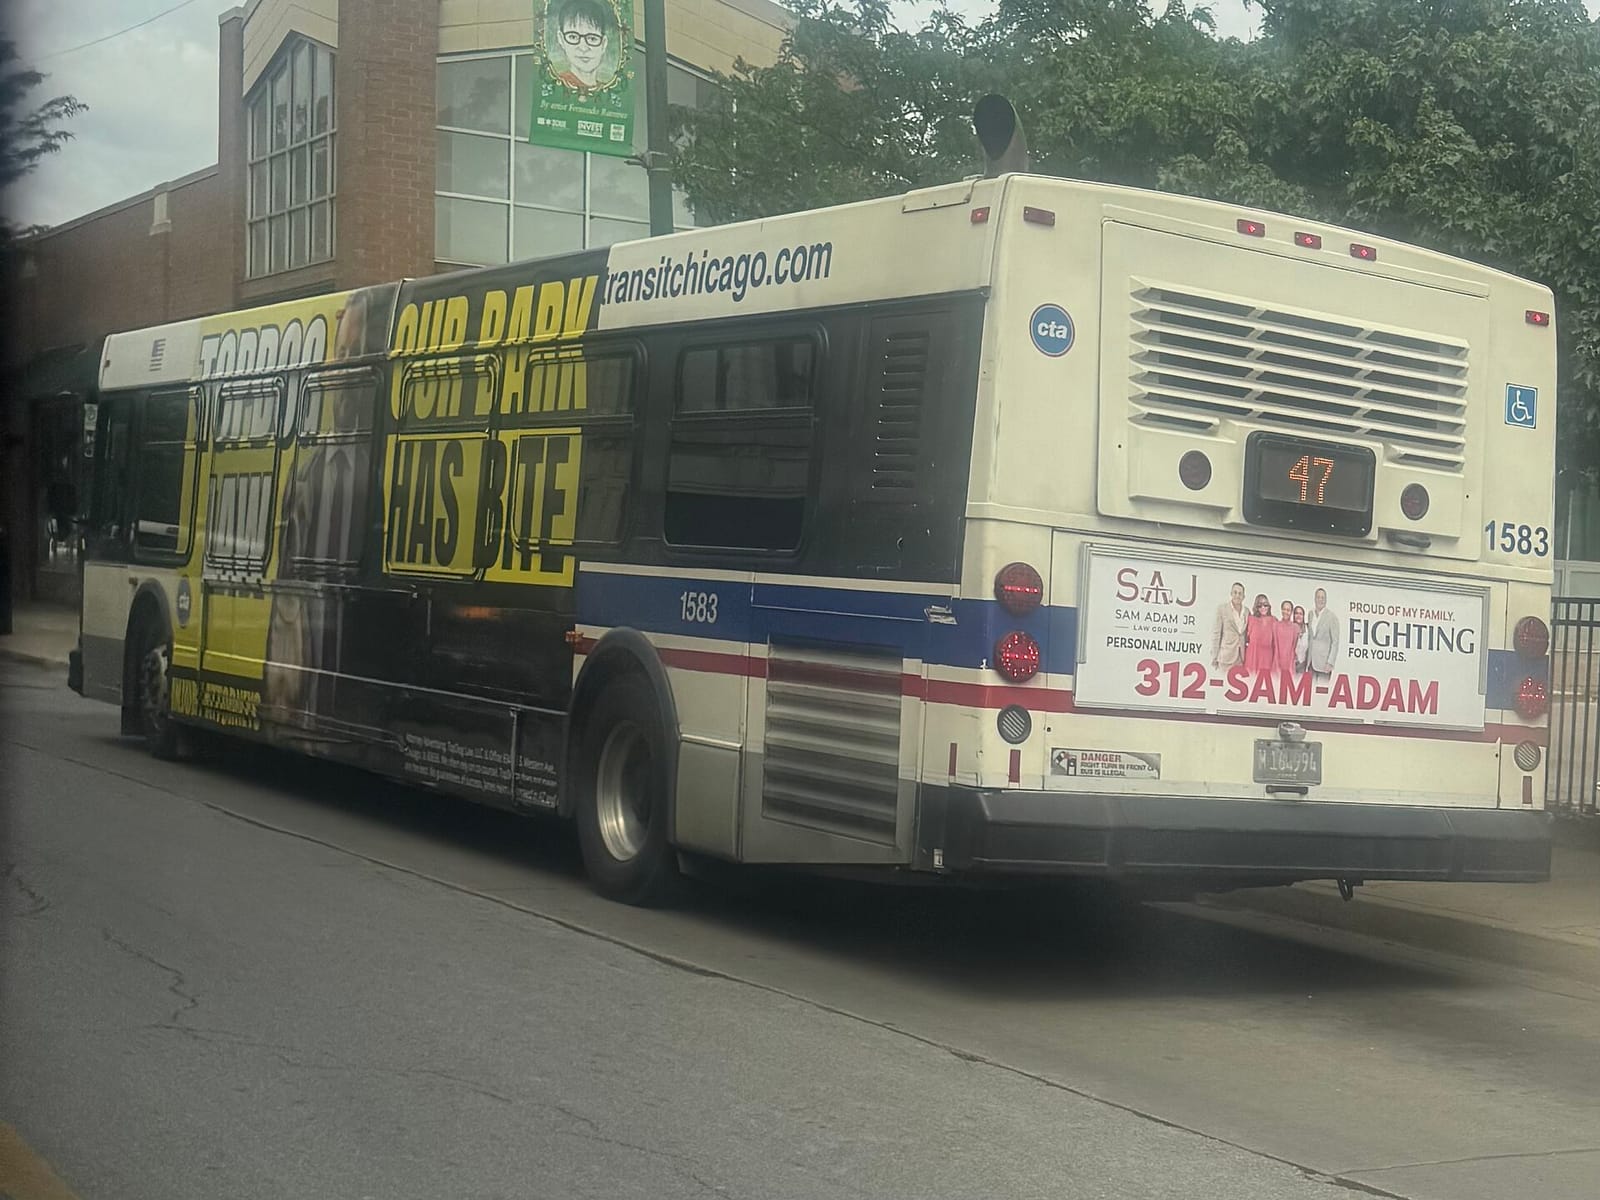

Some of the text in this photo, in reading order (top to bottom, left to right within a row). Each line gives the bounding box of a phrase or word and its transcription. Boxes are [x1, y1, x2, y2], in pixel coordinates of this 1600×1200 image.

[1037, 321, 1068, 339] cta
[387, 275, 599, 420] OUR BARK
[1288, 455, 1334, 504] 47
[387, 436, 571, 574] HAS BITE
[1484, 520, 1549, 557] 1583
[1116, 568, 1197, 607] SAJ
[680, 591, 718, 623] 1583
[1115, 609, 1196, 625] SAM ADAM JR
[1349, 601, 1455, 621] PROUD OF MY FAMILY.
[1133, 624, 1150, 632] LAW
[1348, 618, 1475, 654] FIGHTING
[1106, 636, 1202, 654] PERSONAL INJURY
[1348, 647, 1407, 662] FOR YOURS.
[1134, 658, 1439, 715] 312-SAM-ADAM
[1081, 752, 1121, 763] DANGER
[1101, 762, 1118, 770] TURN
[1101, 769, 1126, 777] ILLEGAL
